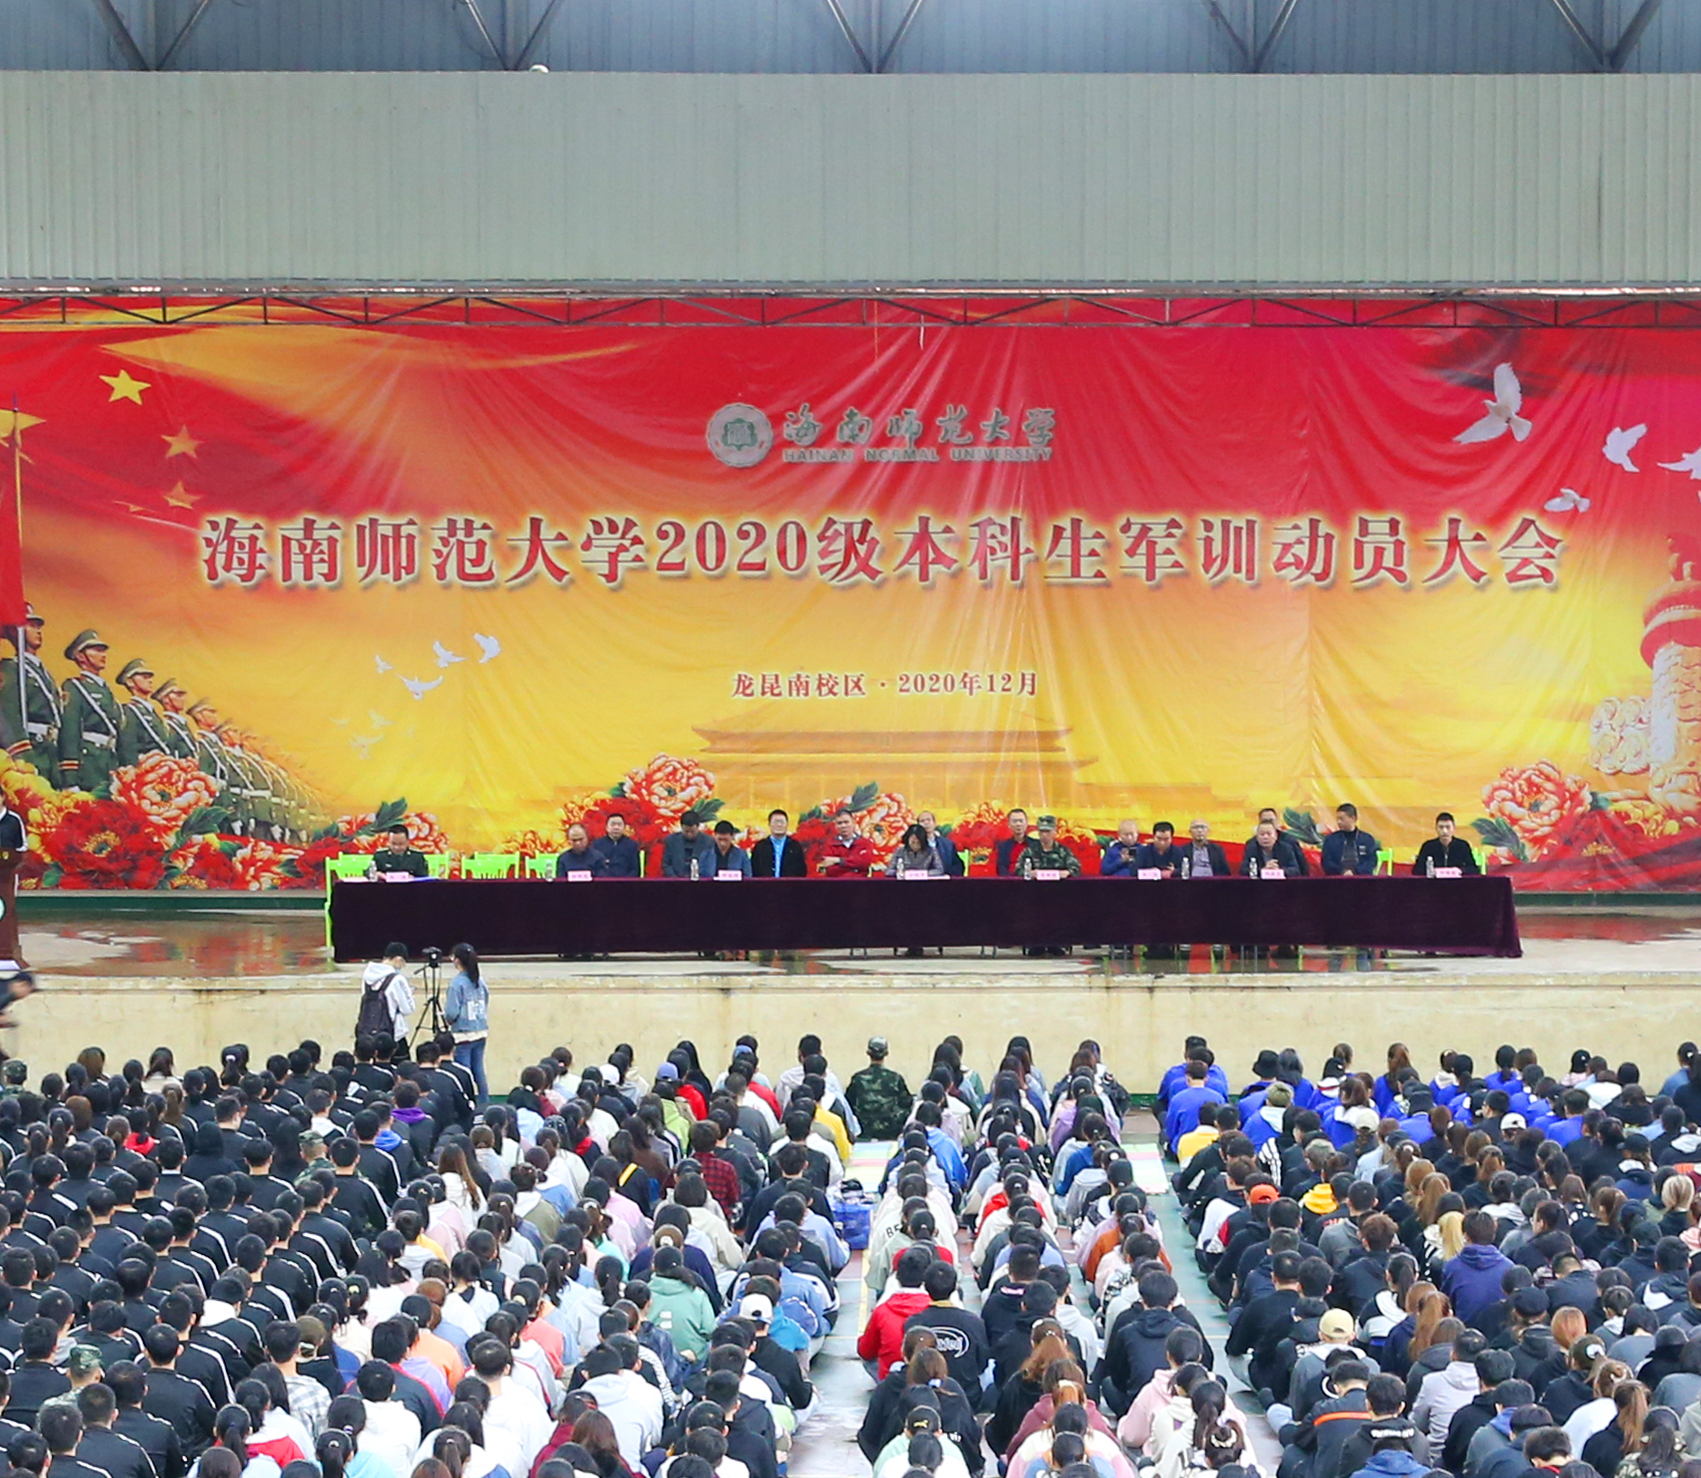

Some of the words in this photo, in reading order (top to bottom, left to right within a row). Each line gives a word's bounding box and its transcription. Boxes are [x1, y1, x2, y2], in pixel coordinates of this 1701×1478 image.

[783, 402, 1055, 447] 海南师范大学
[782, 449, 853, 463] HAINAN
[864, 449, 939, 463] NORMAL
[951, 448, 1052, 463] UNIVERSITY
[202, 515, 1564, 586] 海南师范大学2020级本科生军训动员大会
